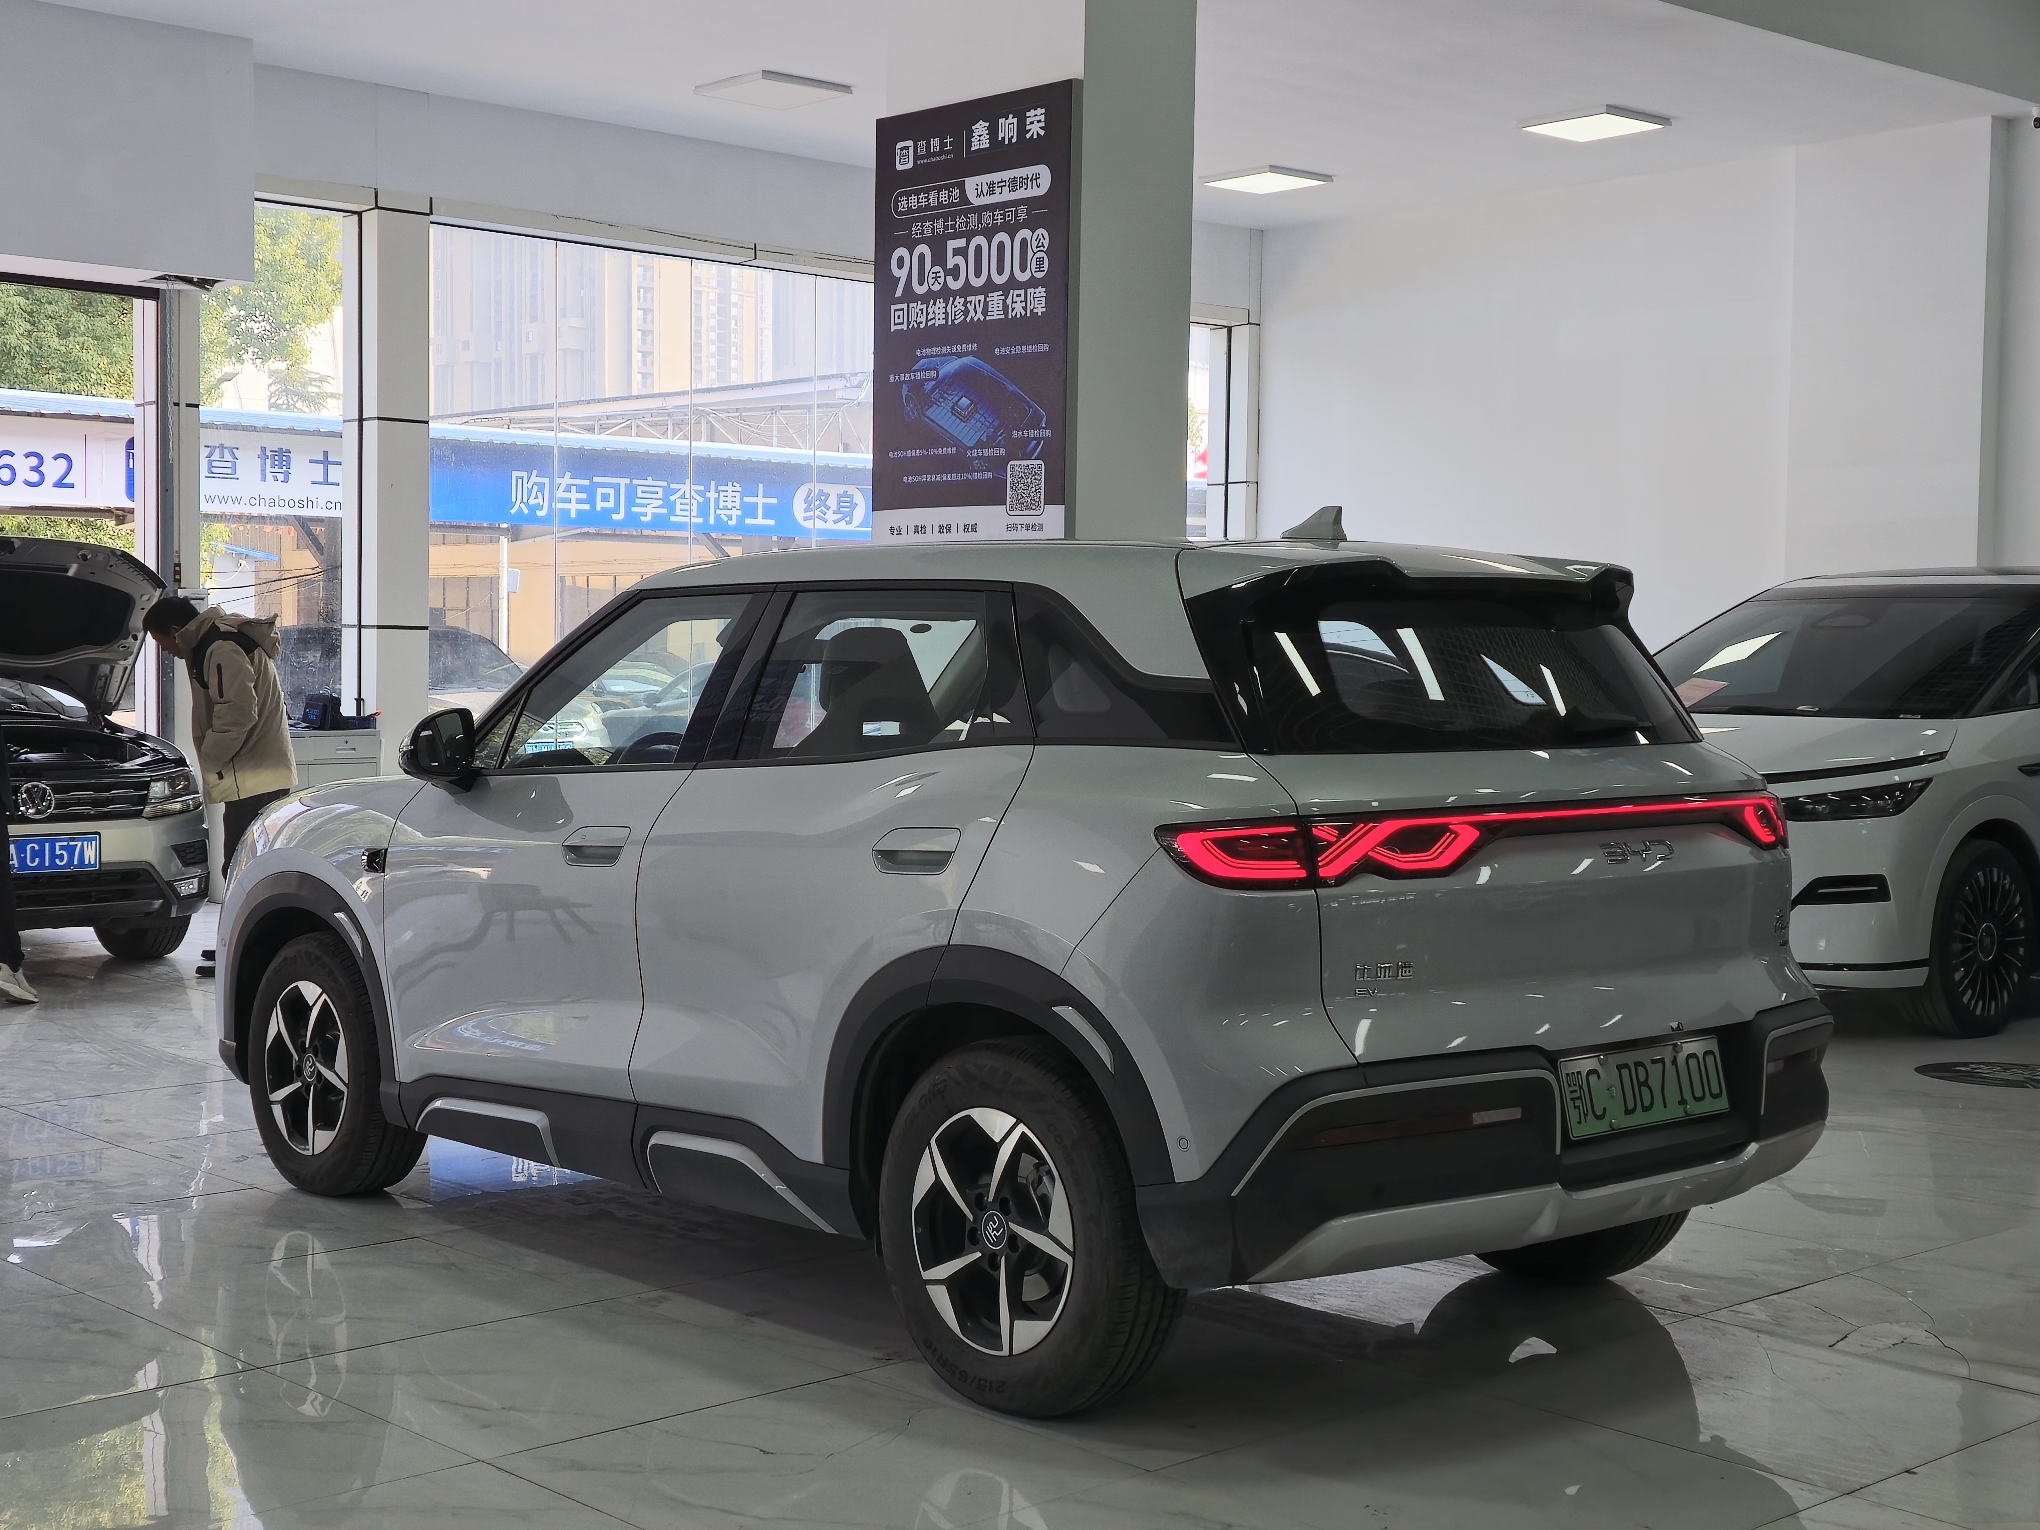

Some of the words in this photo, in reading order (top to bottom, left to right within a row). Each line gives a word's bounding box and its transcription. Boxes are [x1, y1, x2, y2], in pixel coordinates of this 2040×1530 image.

[971, 107, 1046, 151] 鑫响荣
[917, 135, 954, 155] 查博士
[975, 172, 1041, 198] 认准宁德时代
[897, 186, 960, 212] 选电车看电池
[890, 285, 1047, 332] 回购维修双重保障
[204, 443, 342, 487] 查博士
[204, 492, 342, 512] www.chaboshi.cn
[509, 469, 778, 526] 购车可享查博士
[802, 487, 860, 526] 终身
[889, 525, 903, 535] 专业
[962, 523, 978, 533] 权威
[1005, 523, 1044, 532] 扫码下单检测
[1600, 839, 1675, 865] BYD
[1615, 1049, 1724, 1117] DB7100
